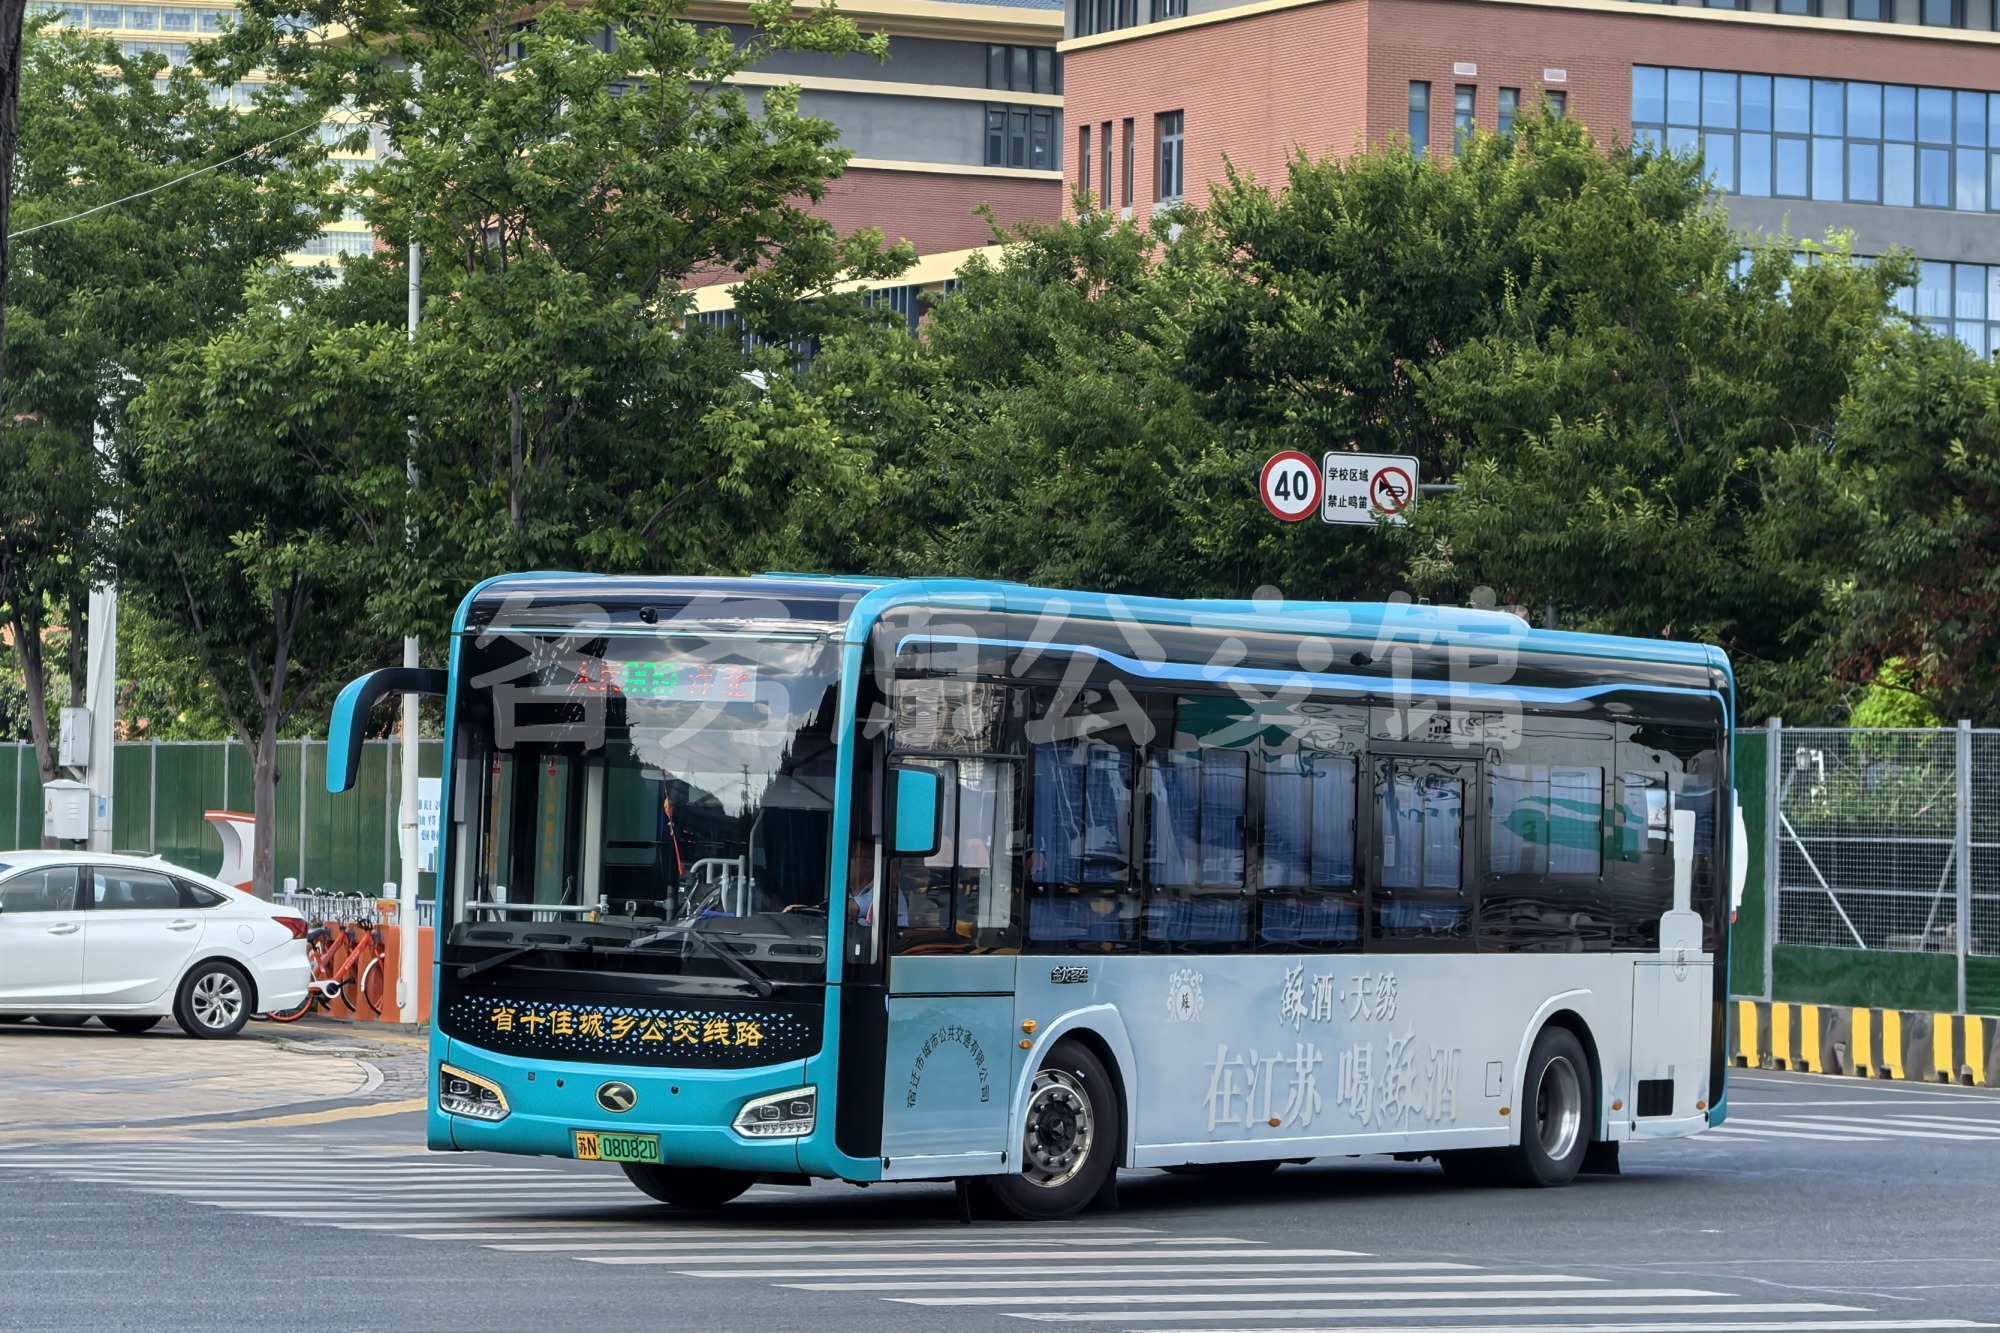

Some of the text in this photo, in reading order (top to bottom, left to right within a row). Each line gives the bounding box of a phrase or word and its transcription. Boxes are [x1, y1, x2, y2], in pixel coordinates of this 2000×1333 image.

[1274, 470, 1309, 502] 40
[1328, 467, 1369, 483] 学校区域
[1327, 494, 1368, 510] 禁止鸣笛
[490, 1006, 765, 1047] 省十佳城乡公交线路
